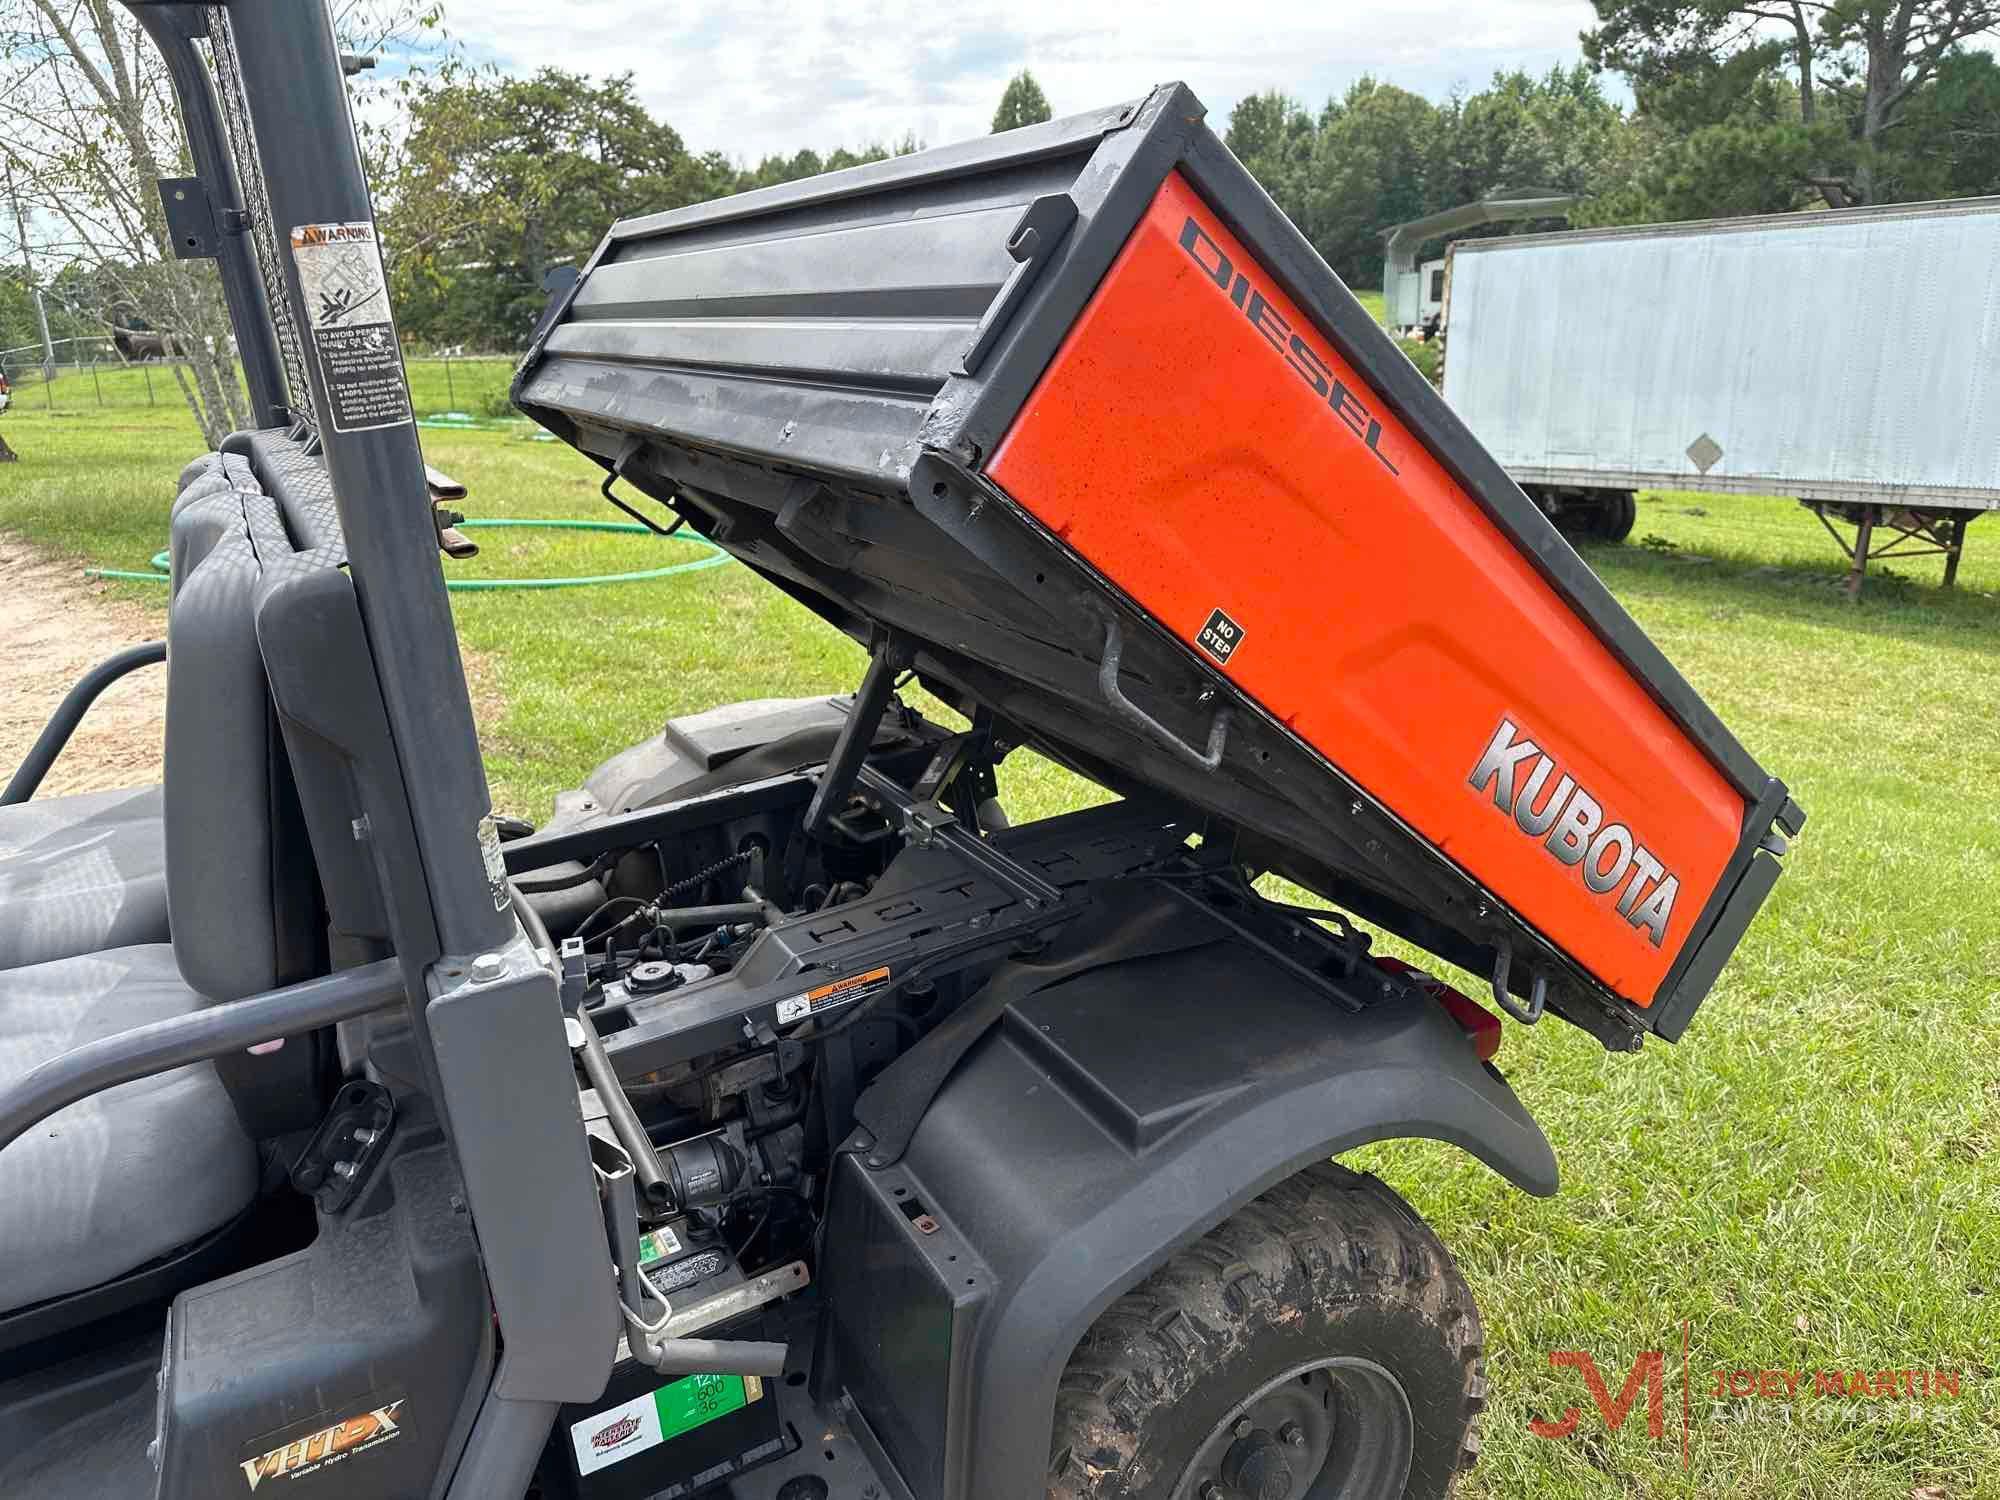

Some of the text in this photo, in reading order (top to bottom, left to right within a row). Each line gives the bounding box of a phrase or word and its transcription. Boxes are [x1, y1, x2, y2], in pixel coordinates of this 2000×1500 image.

[314, 226, 371, 242] WARNING
[317, 332, 329, 340] TO
[329, 329, 355, 339] AVOID
[1178, 216, 1400, 476] DIESEL
[1203, 628, 1231, 654] STEP
[1216, 620, 1234, 638] NO
[1468, 717, 1681, 948] KUBOTA
[839, 975, 869, 990] WARNING
[591, 1415, 643, 1442] INTERSTATE
[593, 1424, 640, 1448] BATTERIES
[240, 1399, 405, 1491] VHT-X
[290, 1430, 401, 1480] Variable Hydro Transmission
